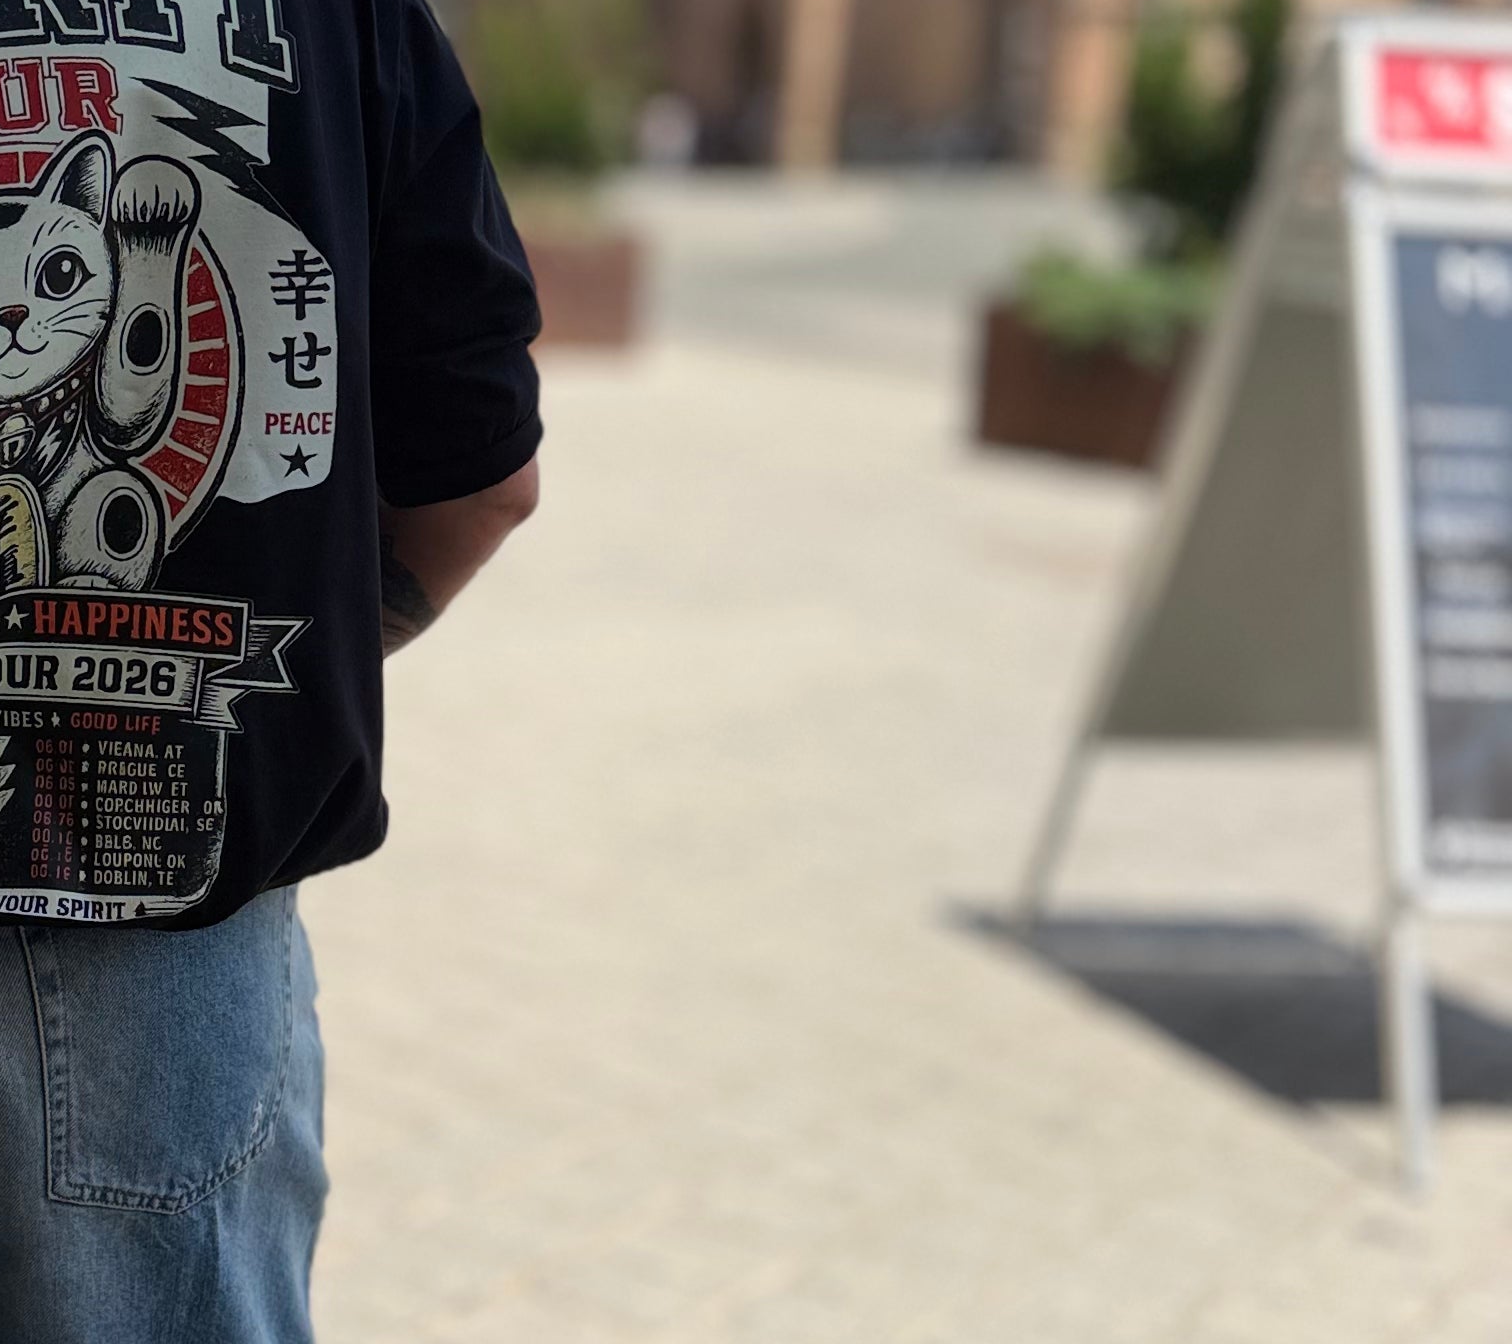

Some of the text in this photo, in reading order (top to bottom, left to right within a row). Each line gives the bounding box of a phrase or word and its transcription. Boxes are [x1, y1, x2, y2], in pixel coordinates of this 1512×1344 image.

[268, 250, 332, 389] 幸せ
[265, 413, 333, 435] PEACE
[33, 600, 235, 646] HAPPINESS
[72, 657, 177, 696] 2026
[125, 715, 161, 736] LIFE
[56, 898, 126, 919] SPIRIT
